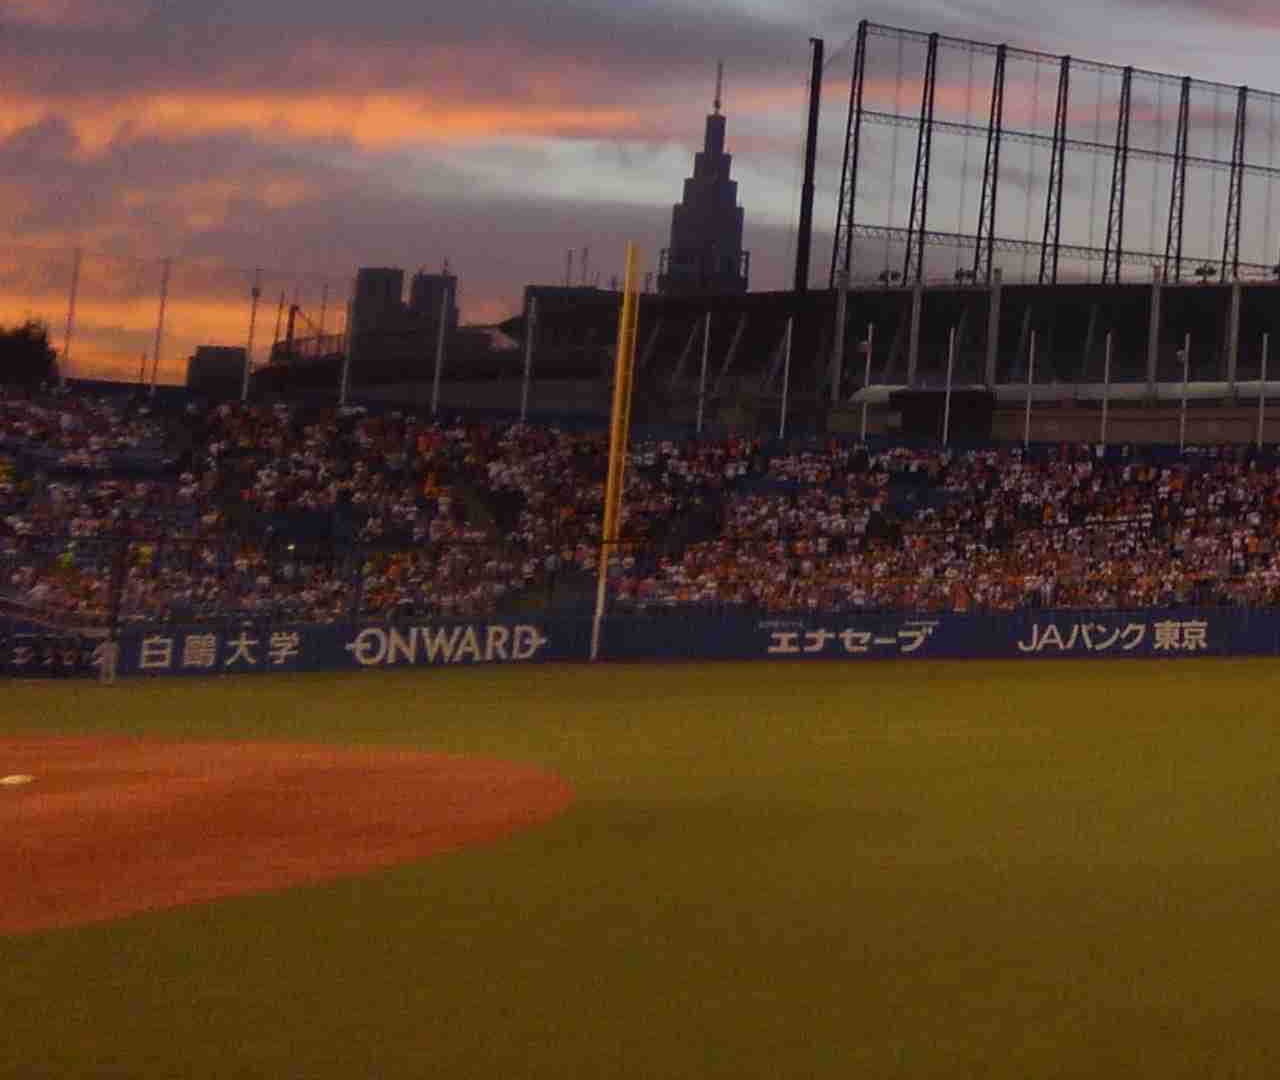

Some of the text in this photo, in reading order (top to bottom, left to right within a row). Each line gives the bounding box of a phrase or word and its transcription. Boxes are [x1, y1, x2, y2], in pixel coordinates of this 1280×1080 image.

[345, 624, 548, 665] ONWARD
[767, 626, 933, 654] エナセーブ
